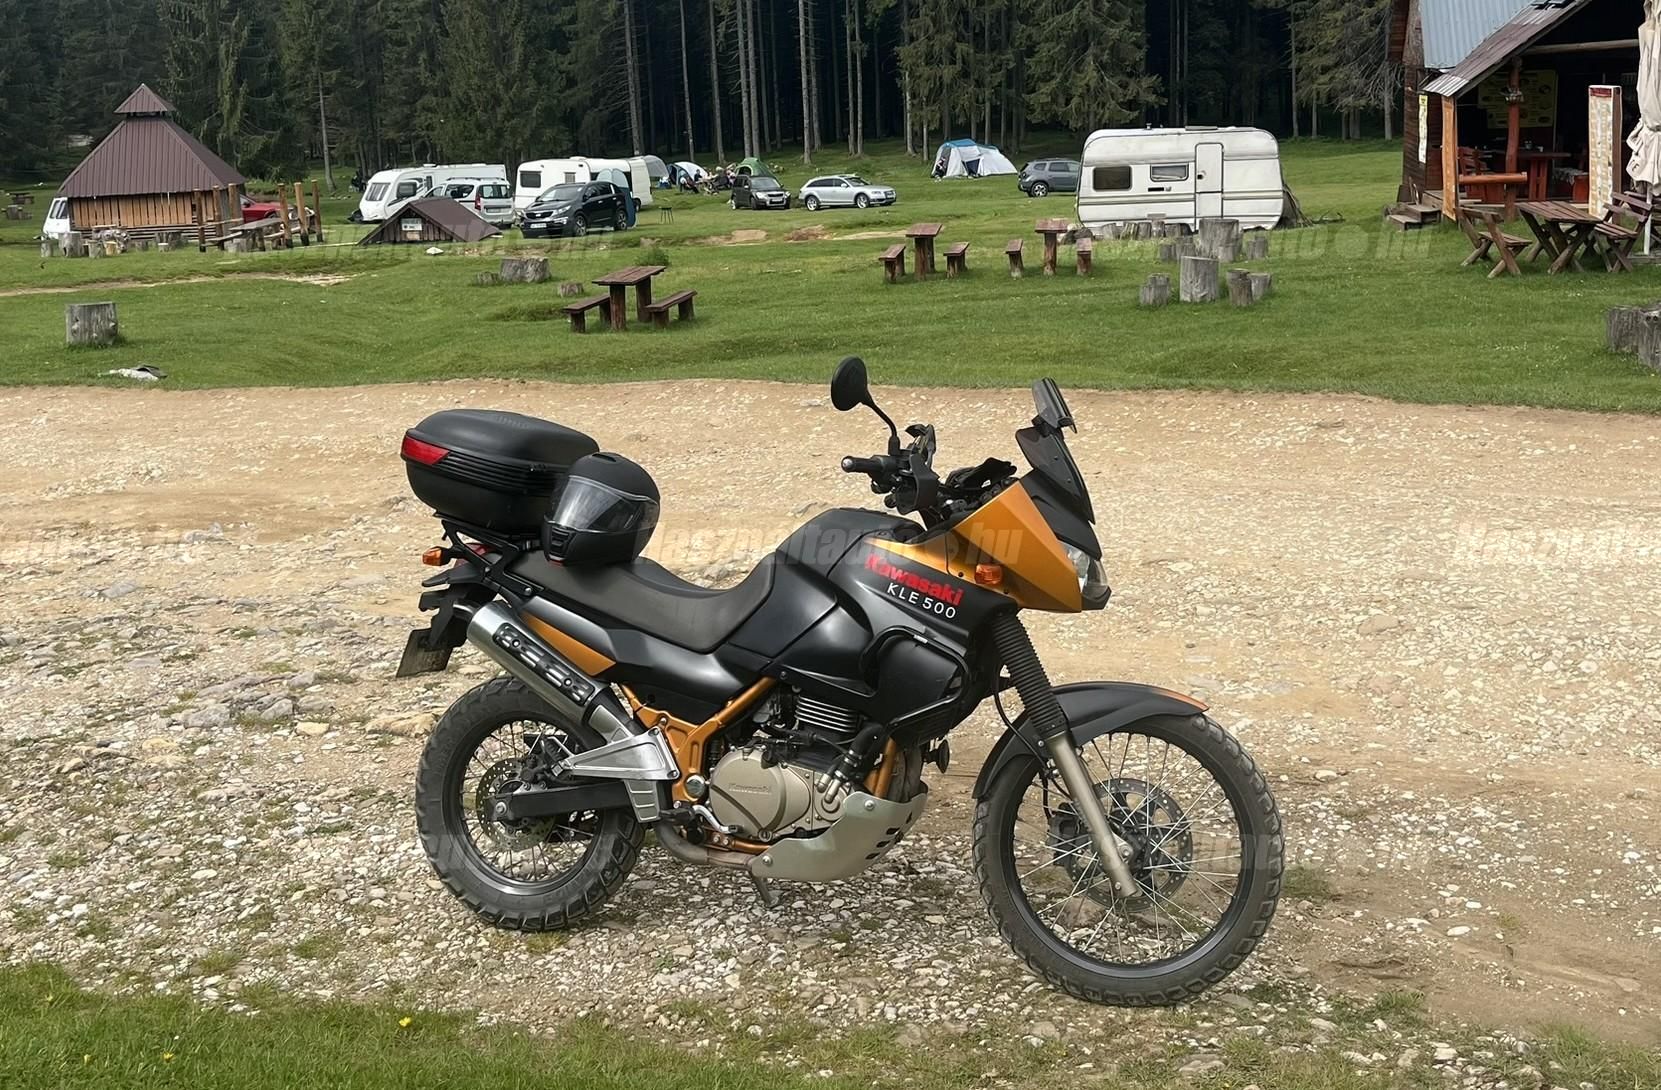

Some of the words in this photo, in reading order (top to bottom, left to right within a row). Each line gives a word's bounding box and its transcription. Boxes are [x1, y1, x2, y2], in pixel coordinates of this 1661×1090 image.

[864, 553, 964, 606] Kawasaki
[887, 582, 920, 604] KLE
[922, 597, 957, 619] 500
